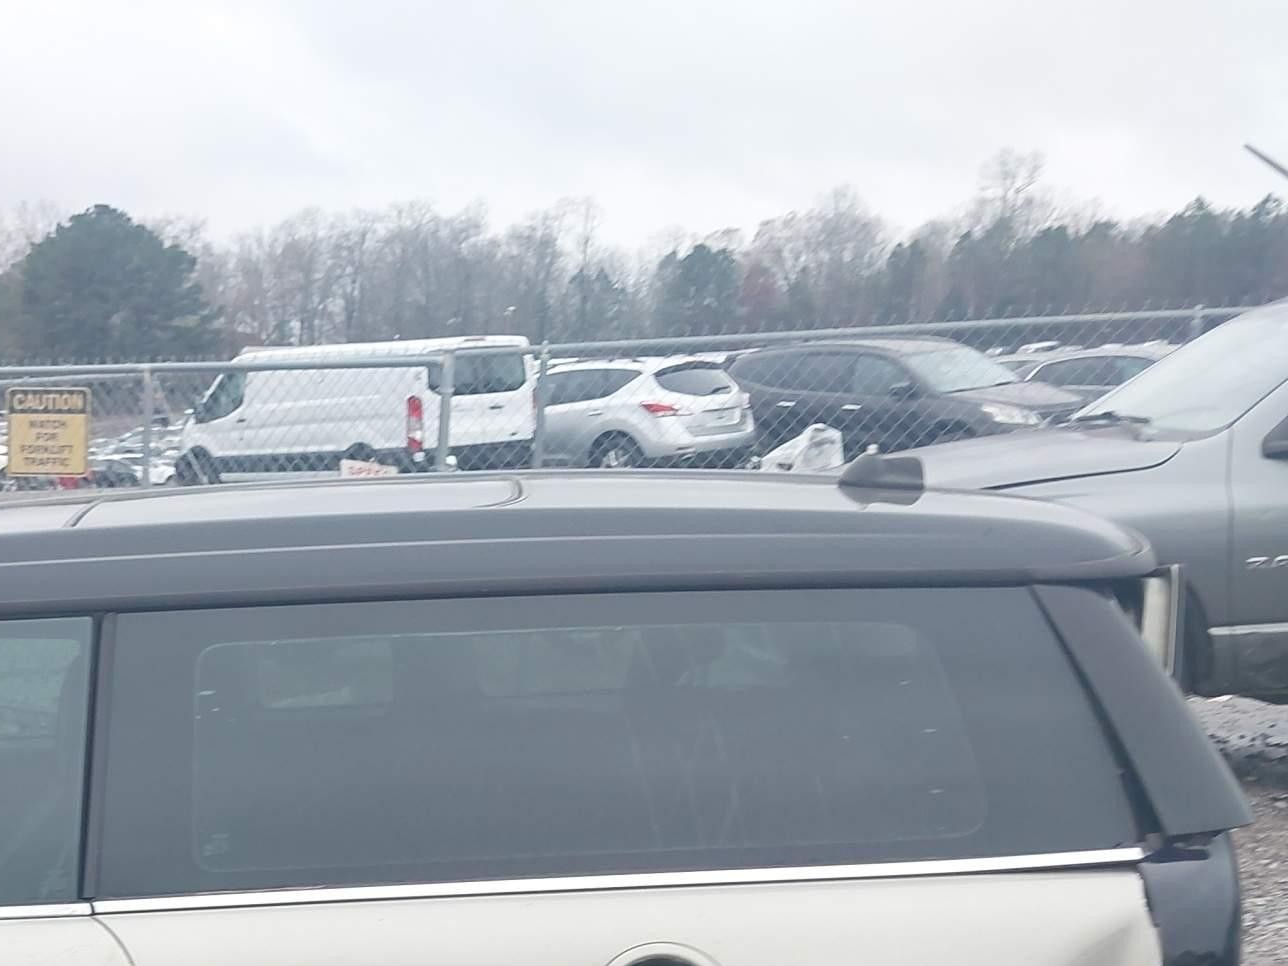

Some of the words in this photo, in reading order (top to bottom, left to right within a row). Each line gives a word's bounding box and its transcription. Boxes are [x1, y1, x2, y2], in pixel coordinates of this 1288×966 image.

[13, 393, 84, 410] CAUTION
[28, 420, 67, 430] WATCH
[35, 431, 58, 442] FOR
[20, 443, 74, 455] FORKLIFT
[23, 456, 71, 468] TRAFFIC
